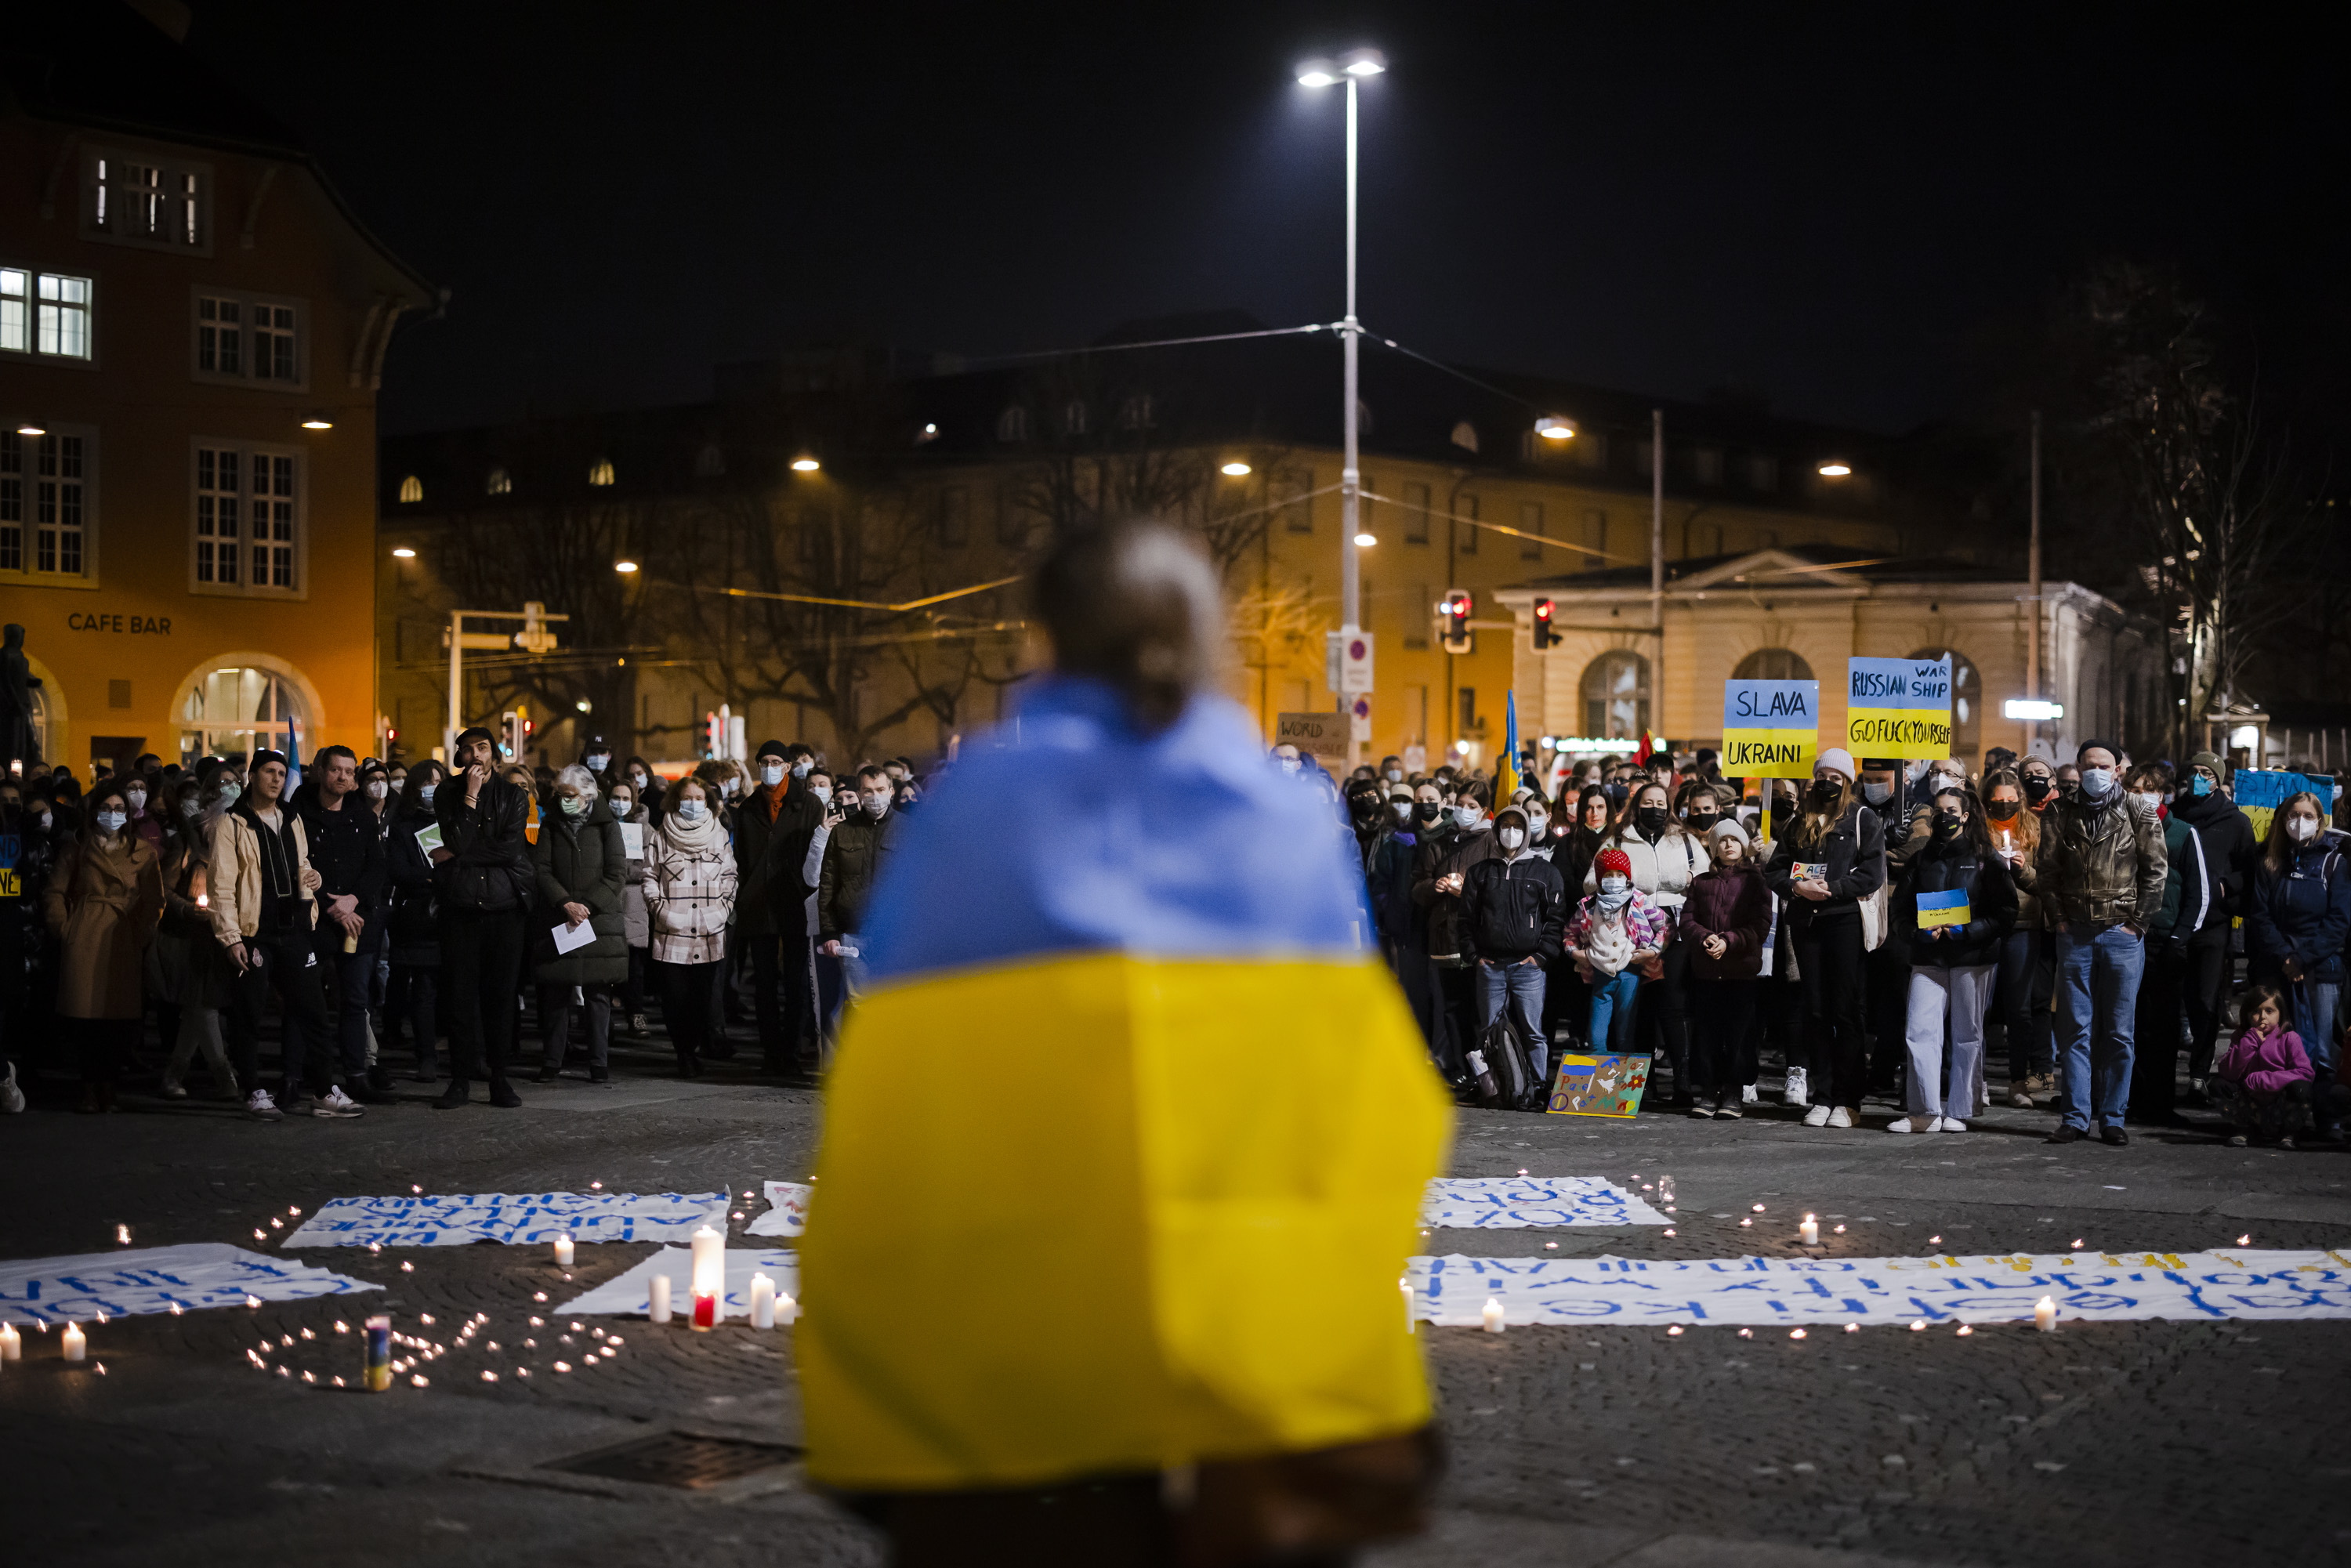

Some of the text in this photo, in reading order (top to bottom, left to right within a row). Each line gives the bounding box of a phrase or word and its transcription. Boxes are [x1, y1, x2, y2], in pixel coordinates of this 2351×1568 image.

[68, 612, 171, 636] CAFE BAR
[1852, 665, 1947, 697] RUSSIAN WAR
[1911, 681, 1947, 698] SHIP
[1736, 691, 1806, 717] SLAVA
[1281, 721, 1323, 738] WORLD
[1728, 741, 1801, 765] UKRAINI
